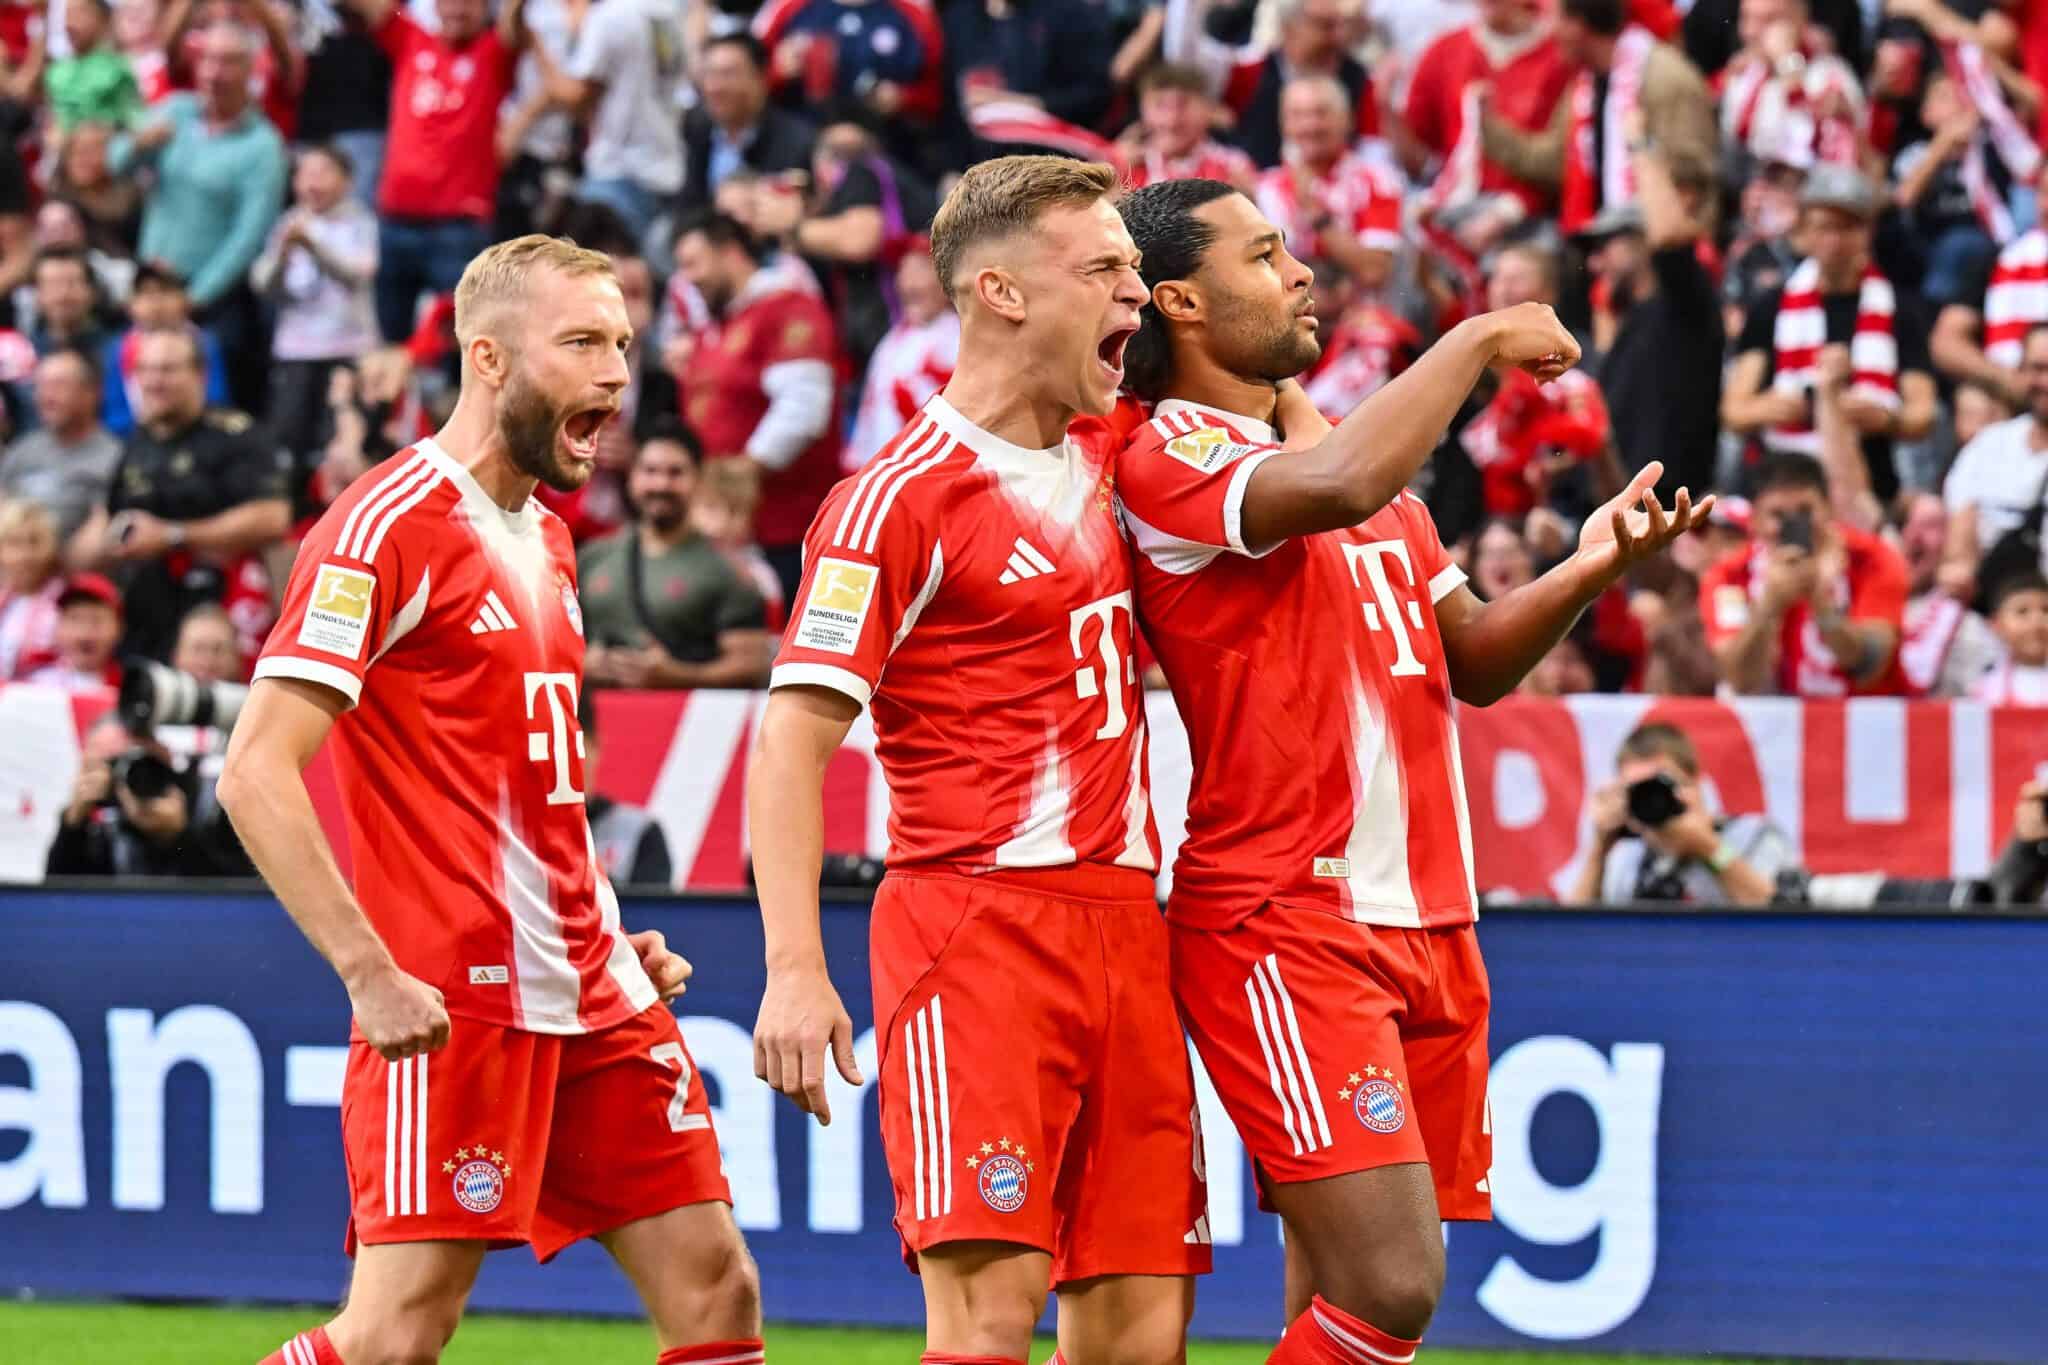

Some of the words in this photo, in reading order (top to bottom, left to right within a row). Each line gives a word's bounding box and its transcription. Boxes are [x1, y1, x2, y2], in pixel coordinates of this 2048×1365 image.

[808, 608, 858, 625] BUNDESLIGA
[1069, 589, 1135, 740] T
[1340, 540, 1427, 676] T
[524, 672, 586, 805] T
[994, 1159, 1025, 1181] BAYERN
